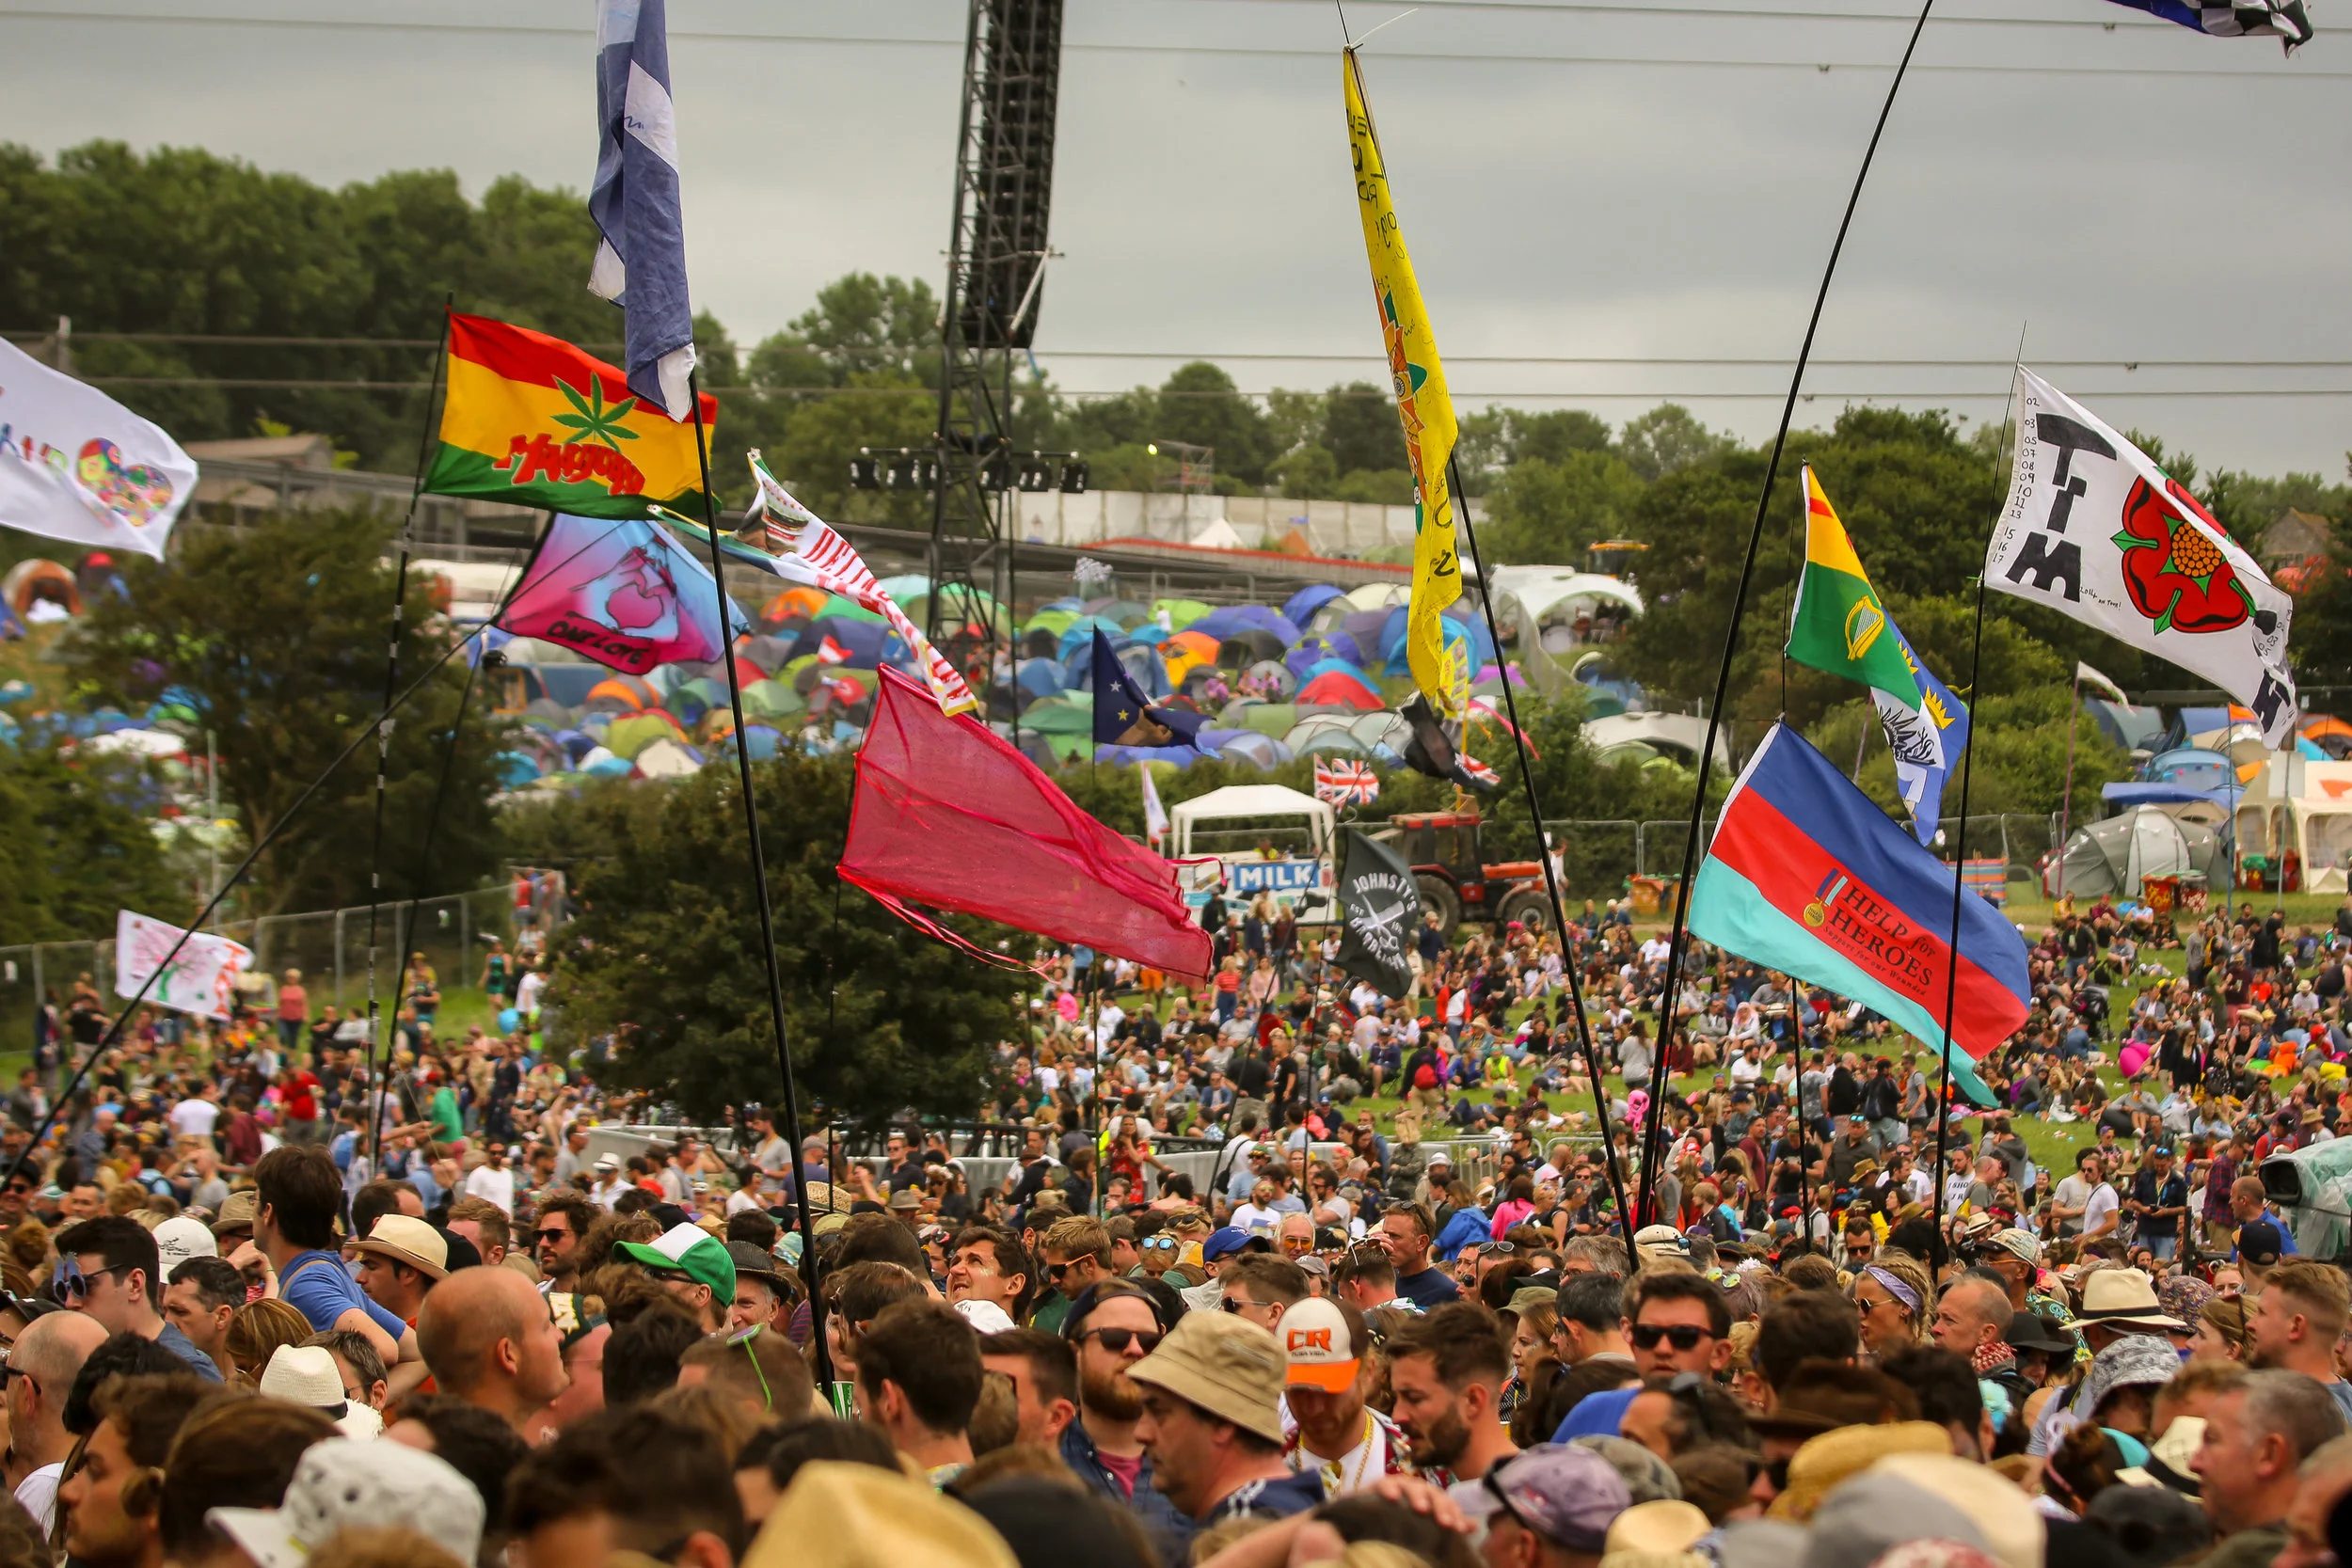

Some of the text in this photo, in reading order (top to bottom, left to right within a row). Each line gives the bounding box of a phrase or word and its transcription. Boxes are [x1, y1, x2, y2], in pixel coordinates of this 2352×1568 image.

[2026, 397, 2040, 406] 02
[2024, 418, 2036, 429] 03
[2024, 436, 2037, 446] 05
[2023, 449, 2037, 458] 07
[2021, 461, 2034, 470] 08
[2019, 472, 2035, 484] 09
[2017, 483, 2032, 498] 10
[2013, 496, 2026, 509] 11
[2010, 510, 2022, 519] 13
[2004, 526, 2016, 540] 15
[1998, 542, 2008, 552] 16
[1993, 553, 2004, 563] 17
[1240, 864, 1314, 888] MILK
[1352, 872, 1417, 912] JOHNSTY'S
[1843, 884, 1909, 938] HELP
[1905, 934, 1936, 958] for
[1828, 906, 1933, 987] HEROES
[1822, 926, 1855, 952] Support
[1871, 960, 1886, 972] our
[1889, 970, 1927, 996] Wounded
[1286, 1327, 1332, 1352] CR
